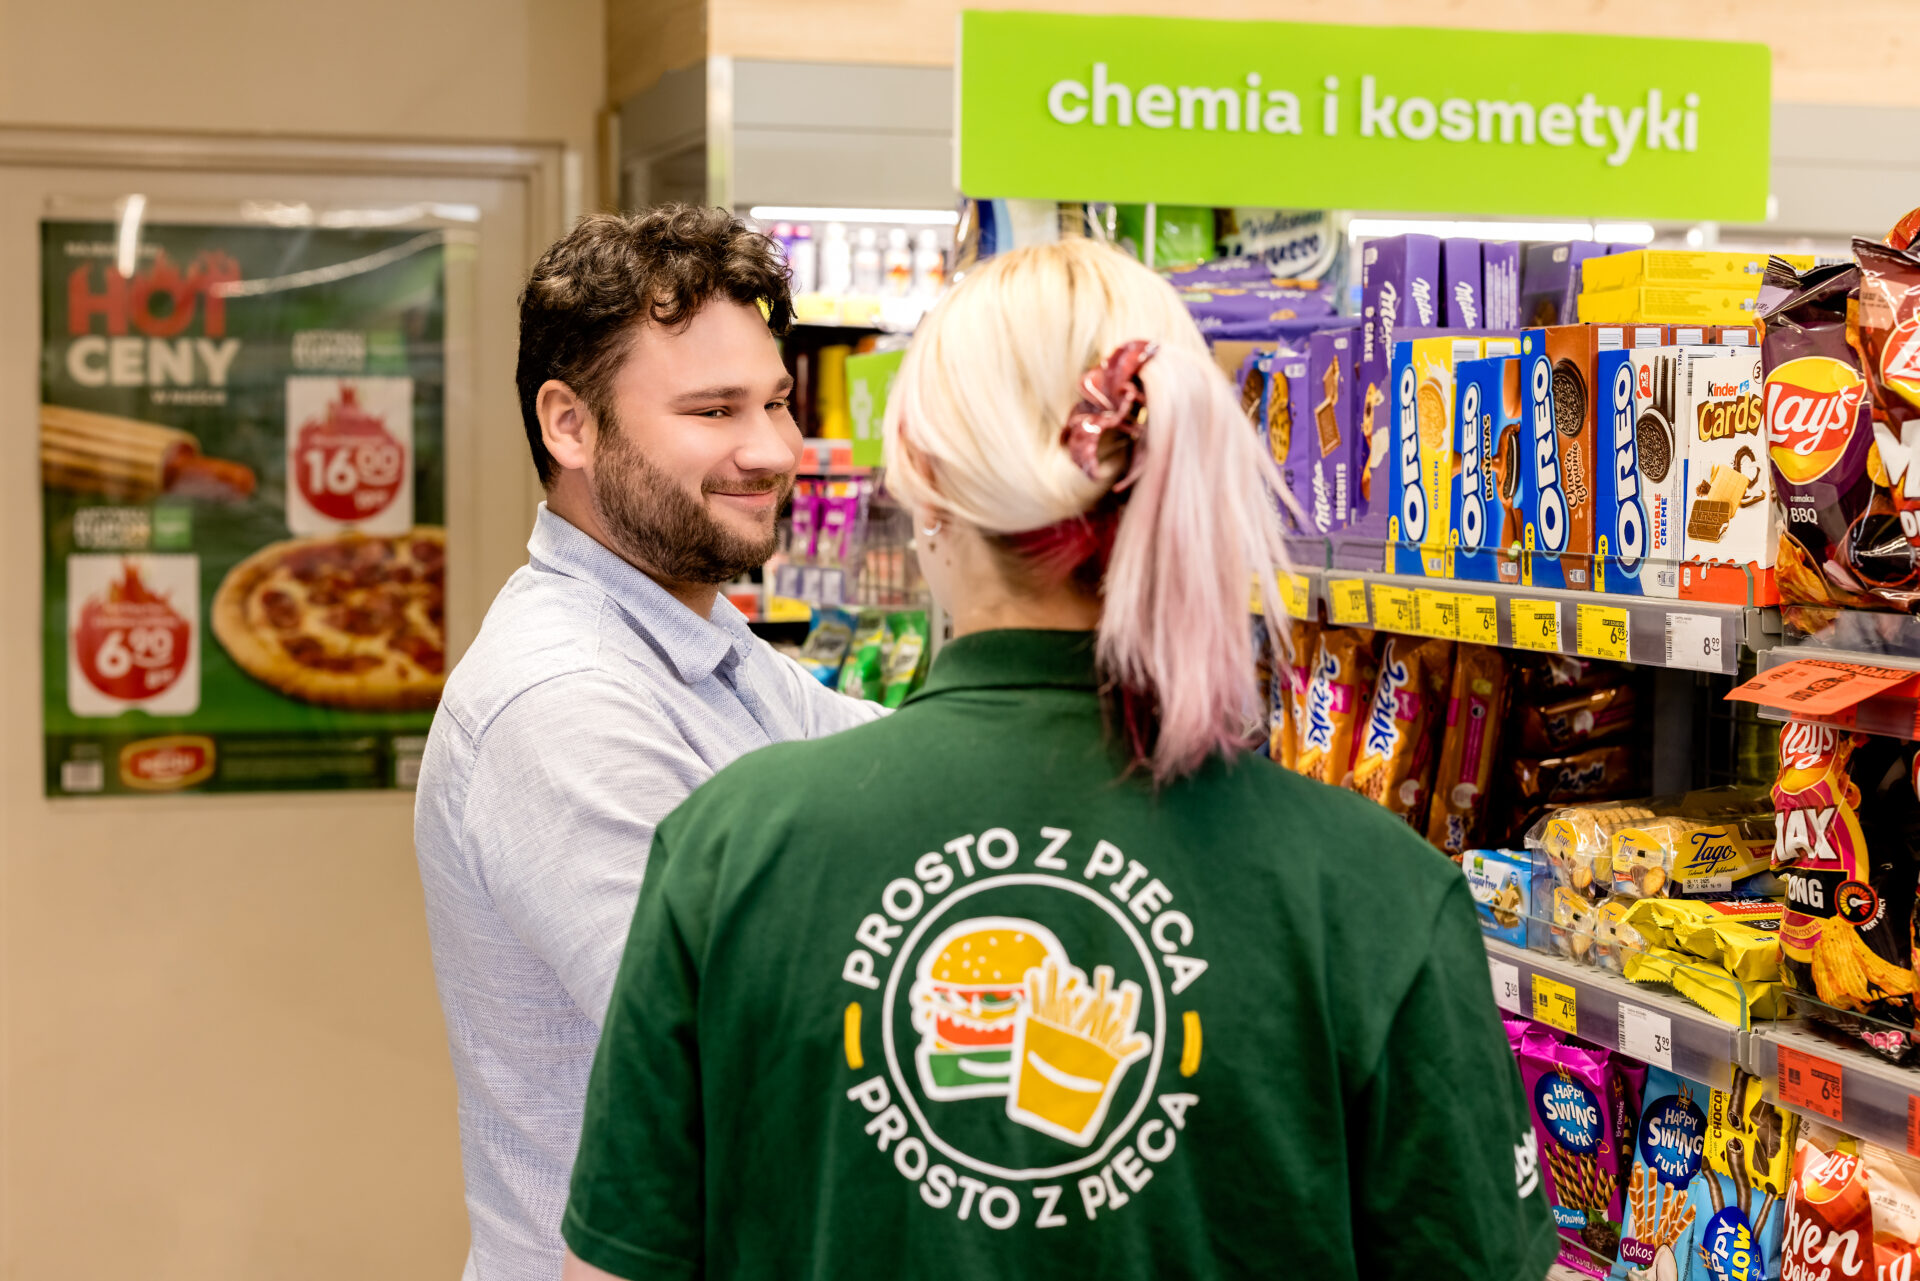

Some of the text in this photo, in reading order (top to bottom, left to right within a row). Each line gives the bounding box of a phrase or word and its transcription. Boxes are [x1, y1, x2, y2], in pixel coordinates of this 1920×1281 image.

[1047, 63, 1701, 167] chemia i kosmetyki
[66, 248, 242, 337] HOT
[1412, 276, 1435, 327] Milka
[1455, 280, 1479, 330] Milka
[66, 336, 242, 387] CENY
[1698, 393, 1763, 442] Cards
[1767, 383, 1855, 456] Lay's
[1399, 364, 1427, 546] OREO
[1460, 382, 1485, 553] OREO
[1531, 356, 1566, 552] OREO
[1572, 441, 1588, 503] Brownie
[1613, 363, 1645, 567] OREO
[1311, 459, 1333, 534] Milka
[1335, 462, 1347, 521] BISCUITS
[1790, 507, 1819, 525] BBQ
[1653, 492, 1662, 550] DOUBLE
[1660, 497, 1668, 547] CREME
[1682, 831, 1737, 873] Tago
[842, 826, 1209, 995] PROSTO Z PIECA
[1860, 897, 1887, 932] VERY SPICY
[1542, 1093, 1598, 1130] SWING
[1552, 1082, 1585, 1102] HAPPY
[1558, 1125, 1594, 1147] rurki
[1647, 1117, 1705, 1158] SWING
[1664, 1107, 1699, 1130] HAPPY
[847, 1076, 1200, 1230] PROSTO Z PIECA
[1654, 1152, 1689, 1178] rurki
[1552, 1207, 1586, 1226] Brownie
[1621, 1241, 1654, 1262] Kokos
